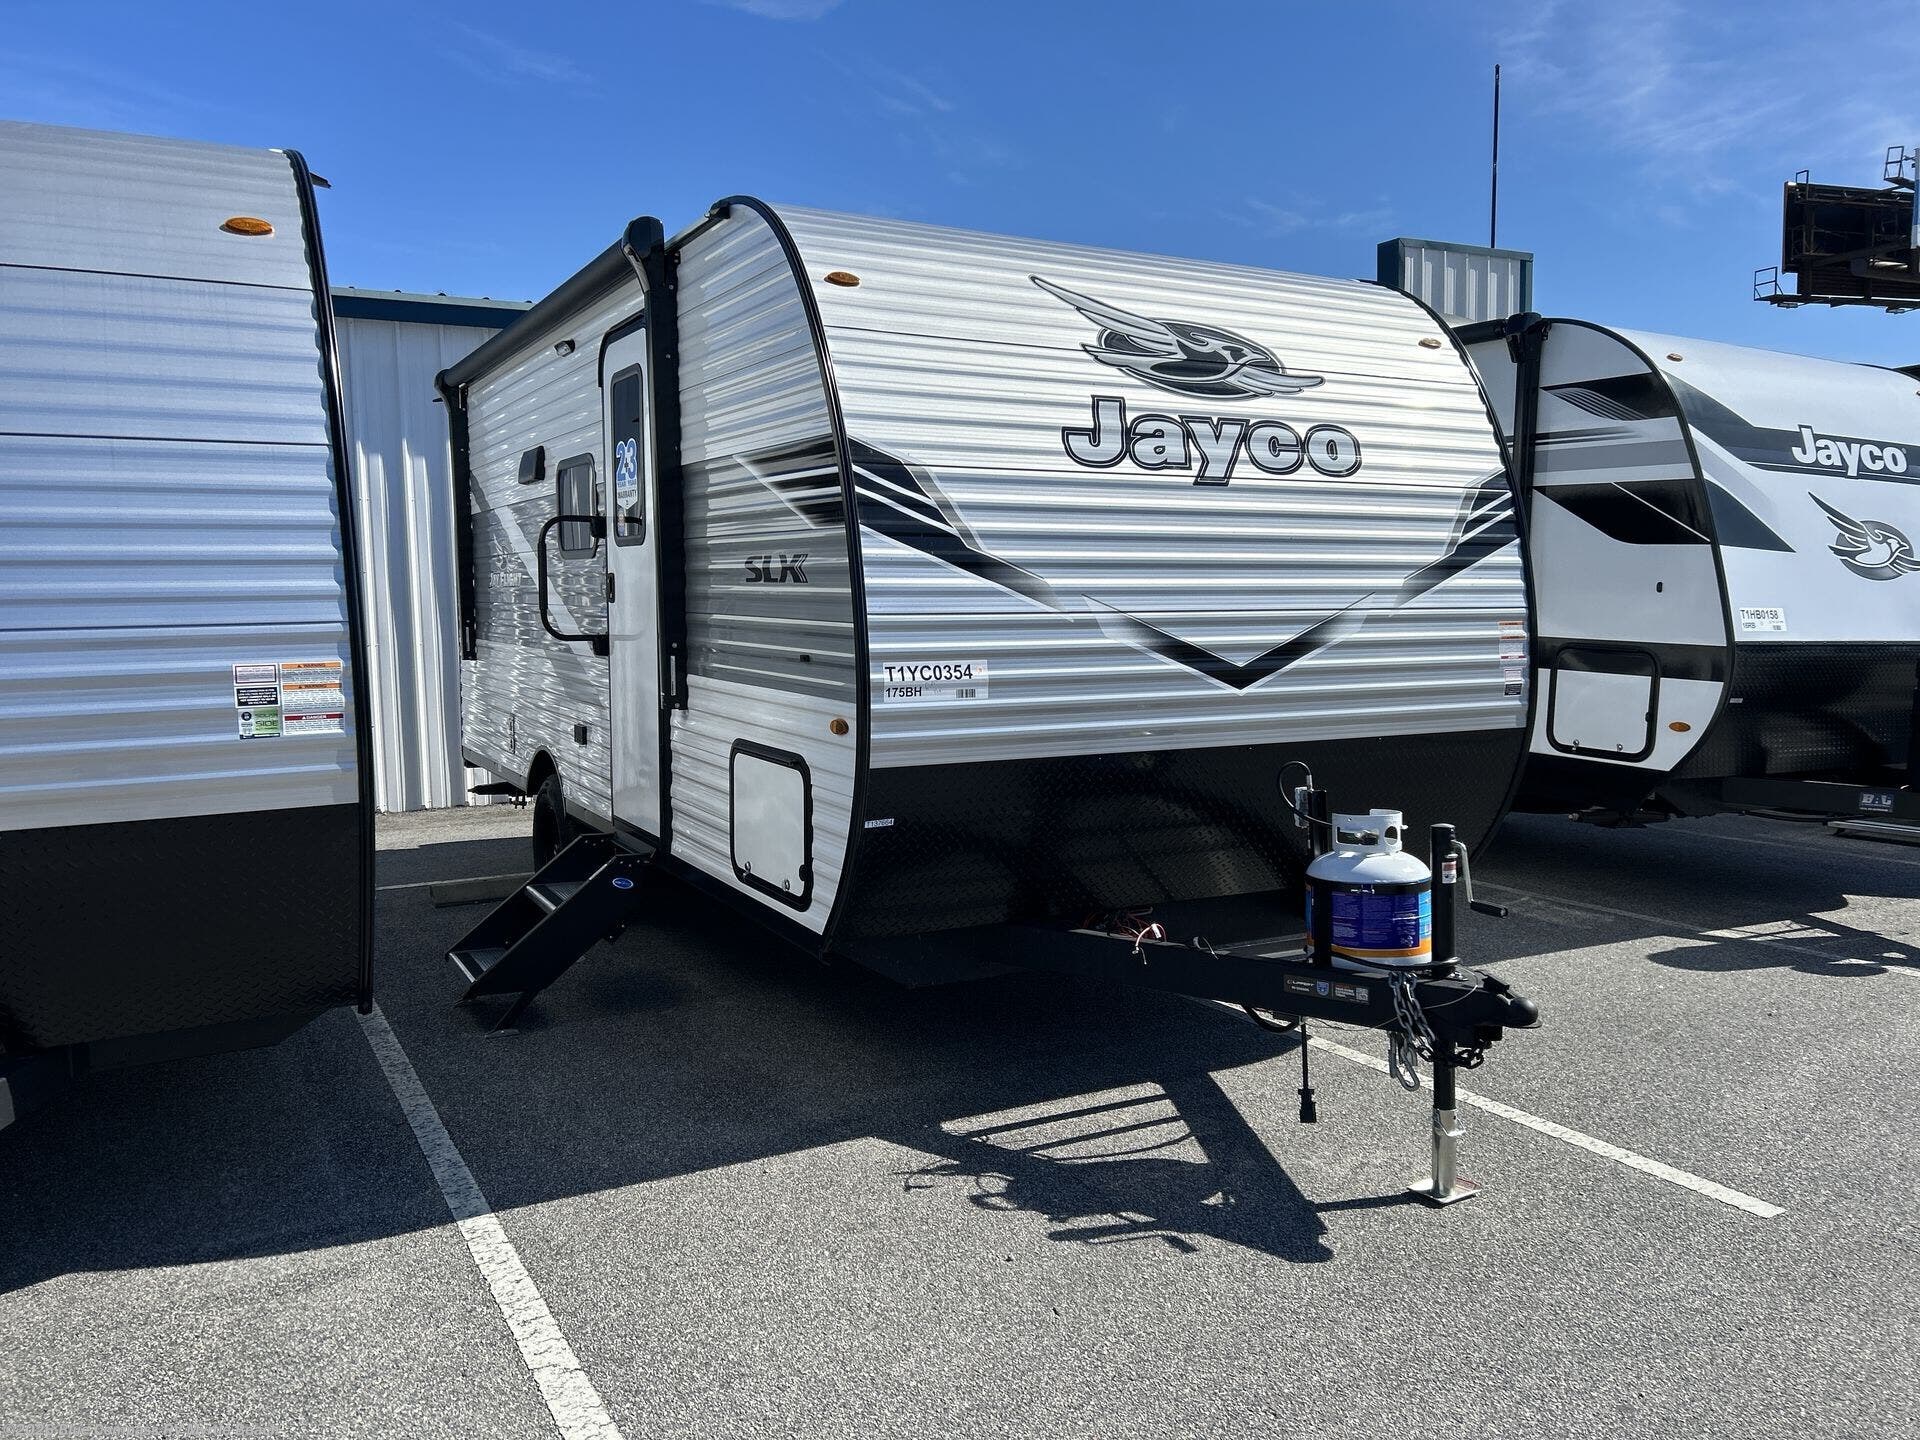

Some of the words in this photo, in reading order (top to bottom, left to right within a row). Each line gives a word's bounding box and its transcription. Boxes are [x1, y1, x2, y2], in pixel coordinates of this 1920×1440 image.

[1061, 395, 1362, 486] Jayco
[1792, 424, 1907, 477] Jayco
[744, 553, 809, 583] SLX
[1740, 609, 1779, 620] T1HB0158
[884, 663, 973, 682] T1YC0354
[885, 686, 922, 698] 175BH
